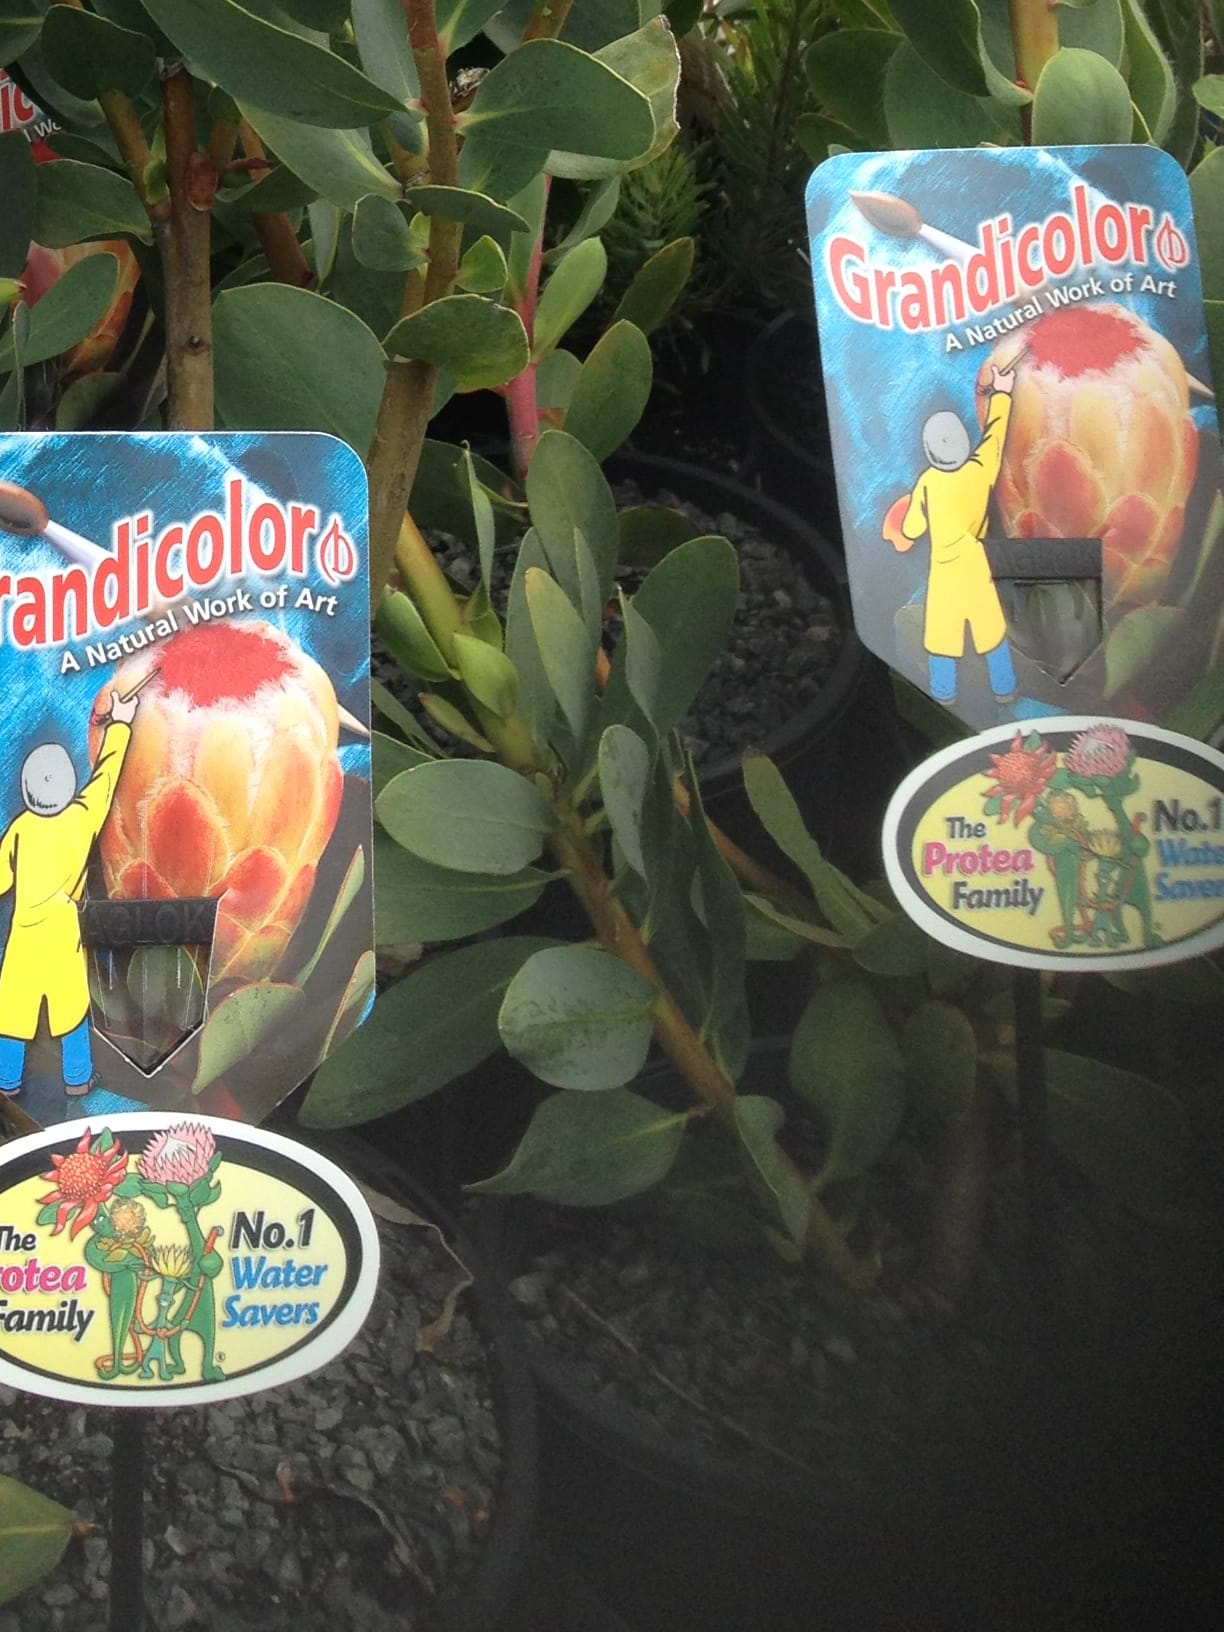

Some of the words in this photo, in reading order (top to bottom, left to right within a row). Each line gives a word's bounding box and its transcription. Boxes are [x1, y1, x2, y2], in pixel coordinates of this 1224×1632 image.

[829, 184, 1152, 333] Grandicolor
[945, 333, 963, 352] A
[967, 297, 1043, 346] Natural
[1045, 276, 1104, 309] Work
[1110, 272, 1134, 292] of
[1140, 276, 1177, 298] Art
[60, 650, 81, 674] A
[85, 615, 178, 668] Natural
[182, 593, 252, 625] Work
[260, 586, 288, 607] of
[294, 588, 339, 616] Art
[945, 816, 986, 839] The
[1152, 797, 1222, 833] No.1
[922, 842, 1034, 877] Protea
[1157, 838, 1224, 866] Wate
[952, 878, 1044, 916] Family
[231, 1209, 315, 1251] No.1
[230, 1256, 328, 1289] Water
[222, 1295, 320, 1329] Savers
